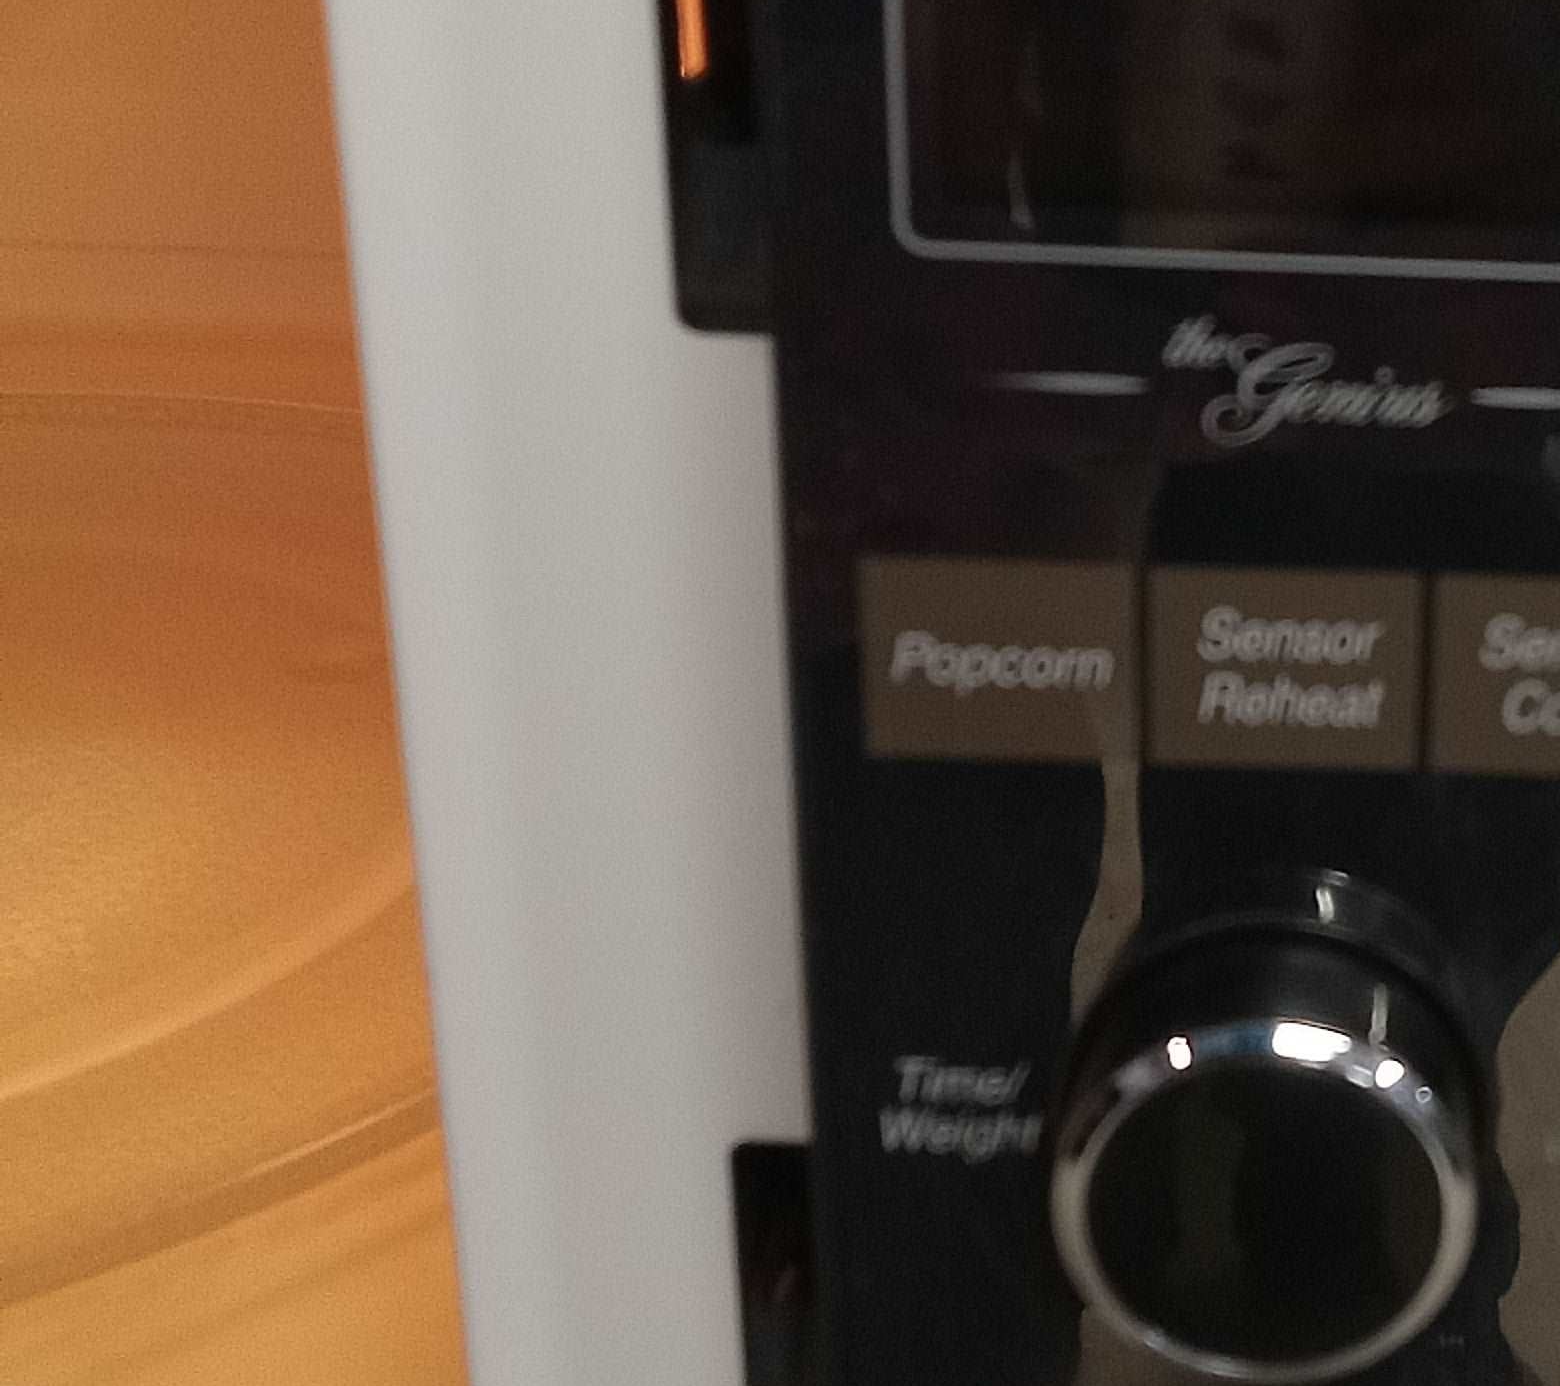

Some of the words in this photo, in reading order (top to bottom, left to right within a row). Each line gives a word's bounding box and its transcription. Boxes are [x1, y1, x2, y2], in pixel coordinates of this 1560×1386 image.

[1200, 332, 1455, 448] Genius
[888, 629, 1115, 697] Popcorn
[1198, 604, 1385, 667] Sensor
[1198, 670, 1385, 730] Reheat
